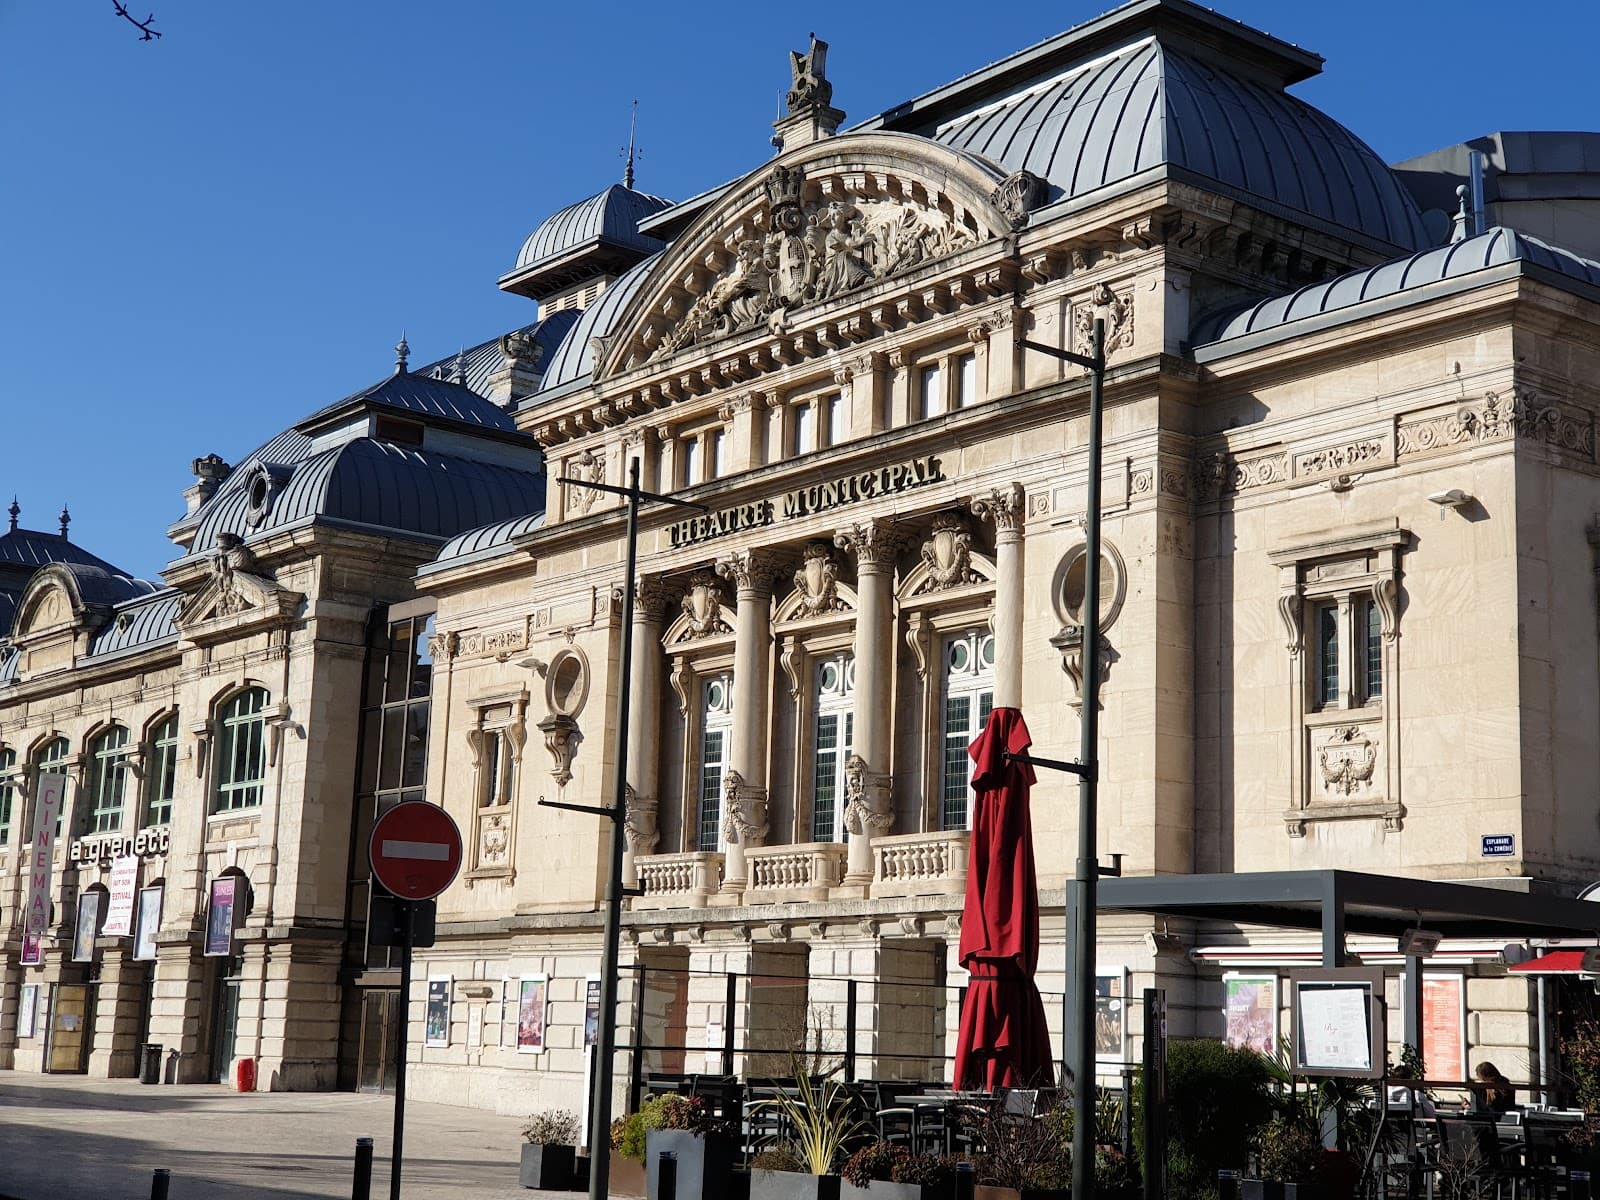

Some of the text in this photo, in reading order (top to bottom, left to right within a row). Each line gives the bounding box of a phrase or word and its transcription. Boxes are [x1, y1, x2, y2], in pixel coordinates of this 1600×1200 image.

[664, 456, 938, 546] THEATRE MUNICIPAL
[33, 789, 55, 911] CINEMA
